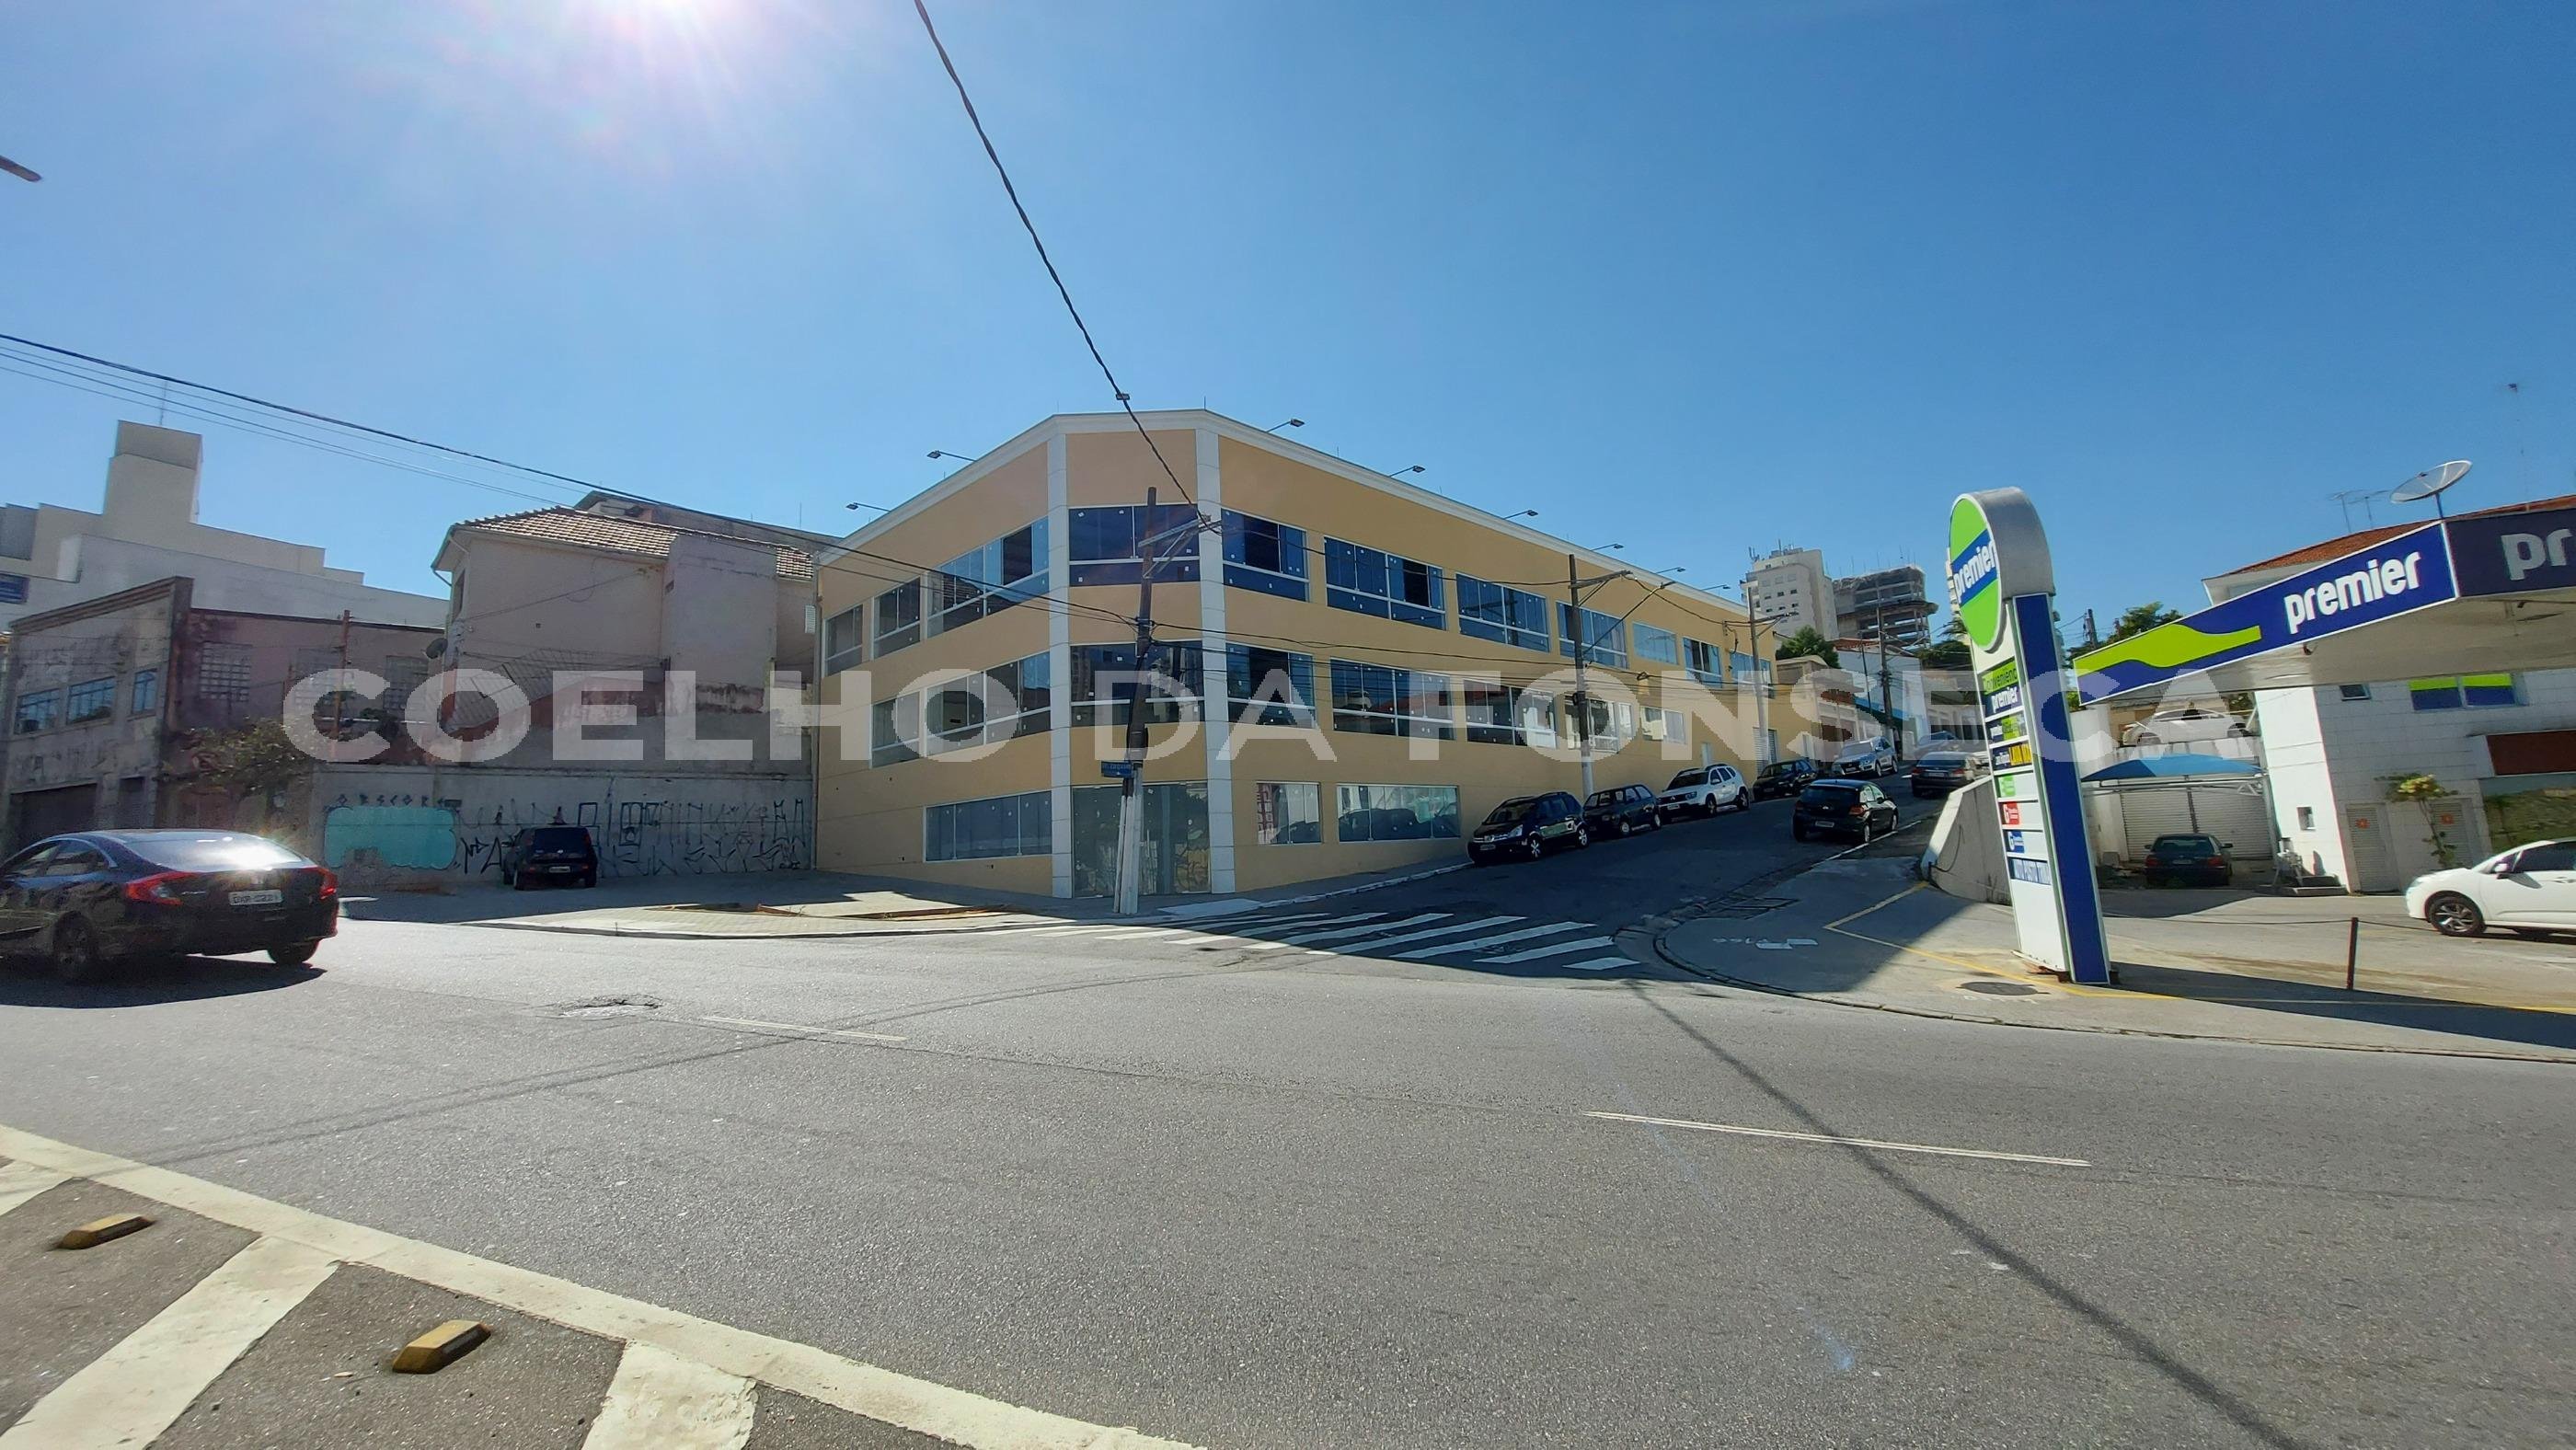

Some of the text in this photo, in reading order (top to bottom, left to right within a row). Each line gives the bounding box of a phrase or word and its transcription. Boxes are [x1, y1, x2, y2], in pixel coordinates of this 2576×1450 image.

[1953, 539, 1996, 604] premier
[2283, 551, 2421, 635] premier
[1991, 685, 2018, 713] premier
